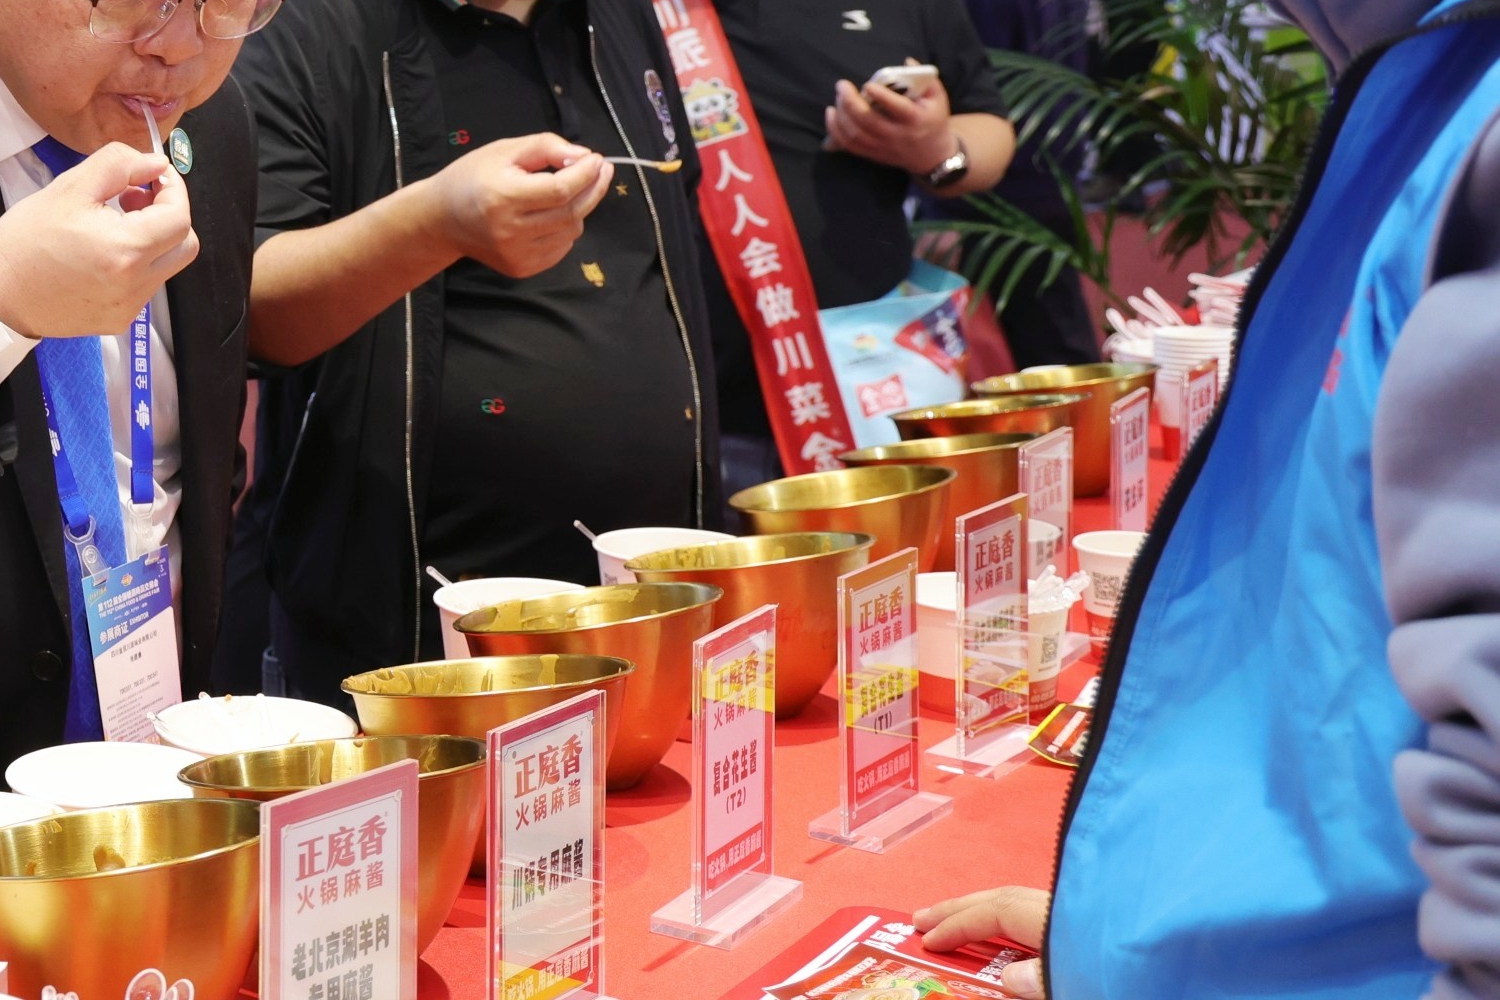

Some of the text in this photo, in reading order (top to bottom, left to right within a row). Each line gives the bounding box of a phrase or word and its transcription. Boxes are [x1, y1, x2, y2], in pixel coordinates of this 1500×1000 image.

[975, 529, 1015, 572] 正庭香
[858, 584, 906, 635] 正庭香
[859, 619, 904, 656] 火锅麻酱
[712, 649, 760, 706] 正庭香
[713, 688, 759, 732] 火锅麻酱
[513, 733, 583, 800] 正庭香
[712, 739, 758, 798] 复合花生酱
[514, 778, 583, 832] 火锅麻酱
[725, 788, 748, 816] (T2)
[296, 813, 388, 884] 正庭香
[511, 837, 585, 911] 川锅专用麻酱
[296, 861, 385, 915] 火锅麻酱
[291, 913, 392, 982] 老北京涮羊肉
